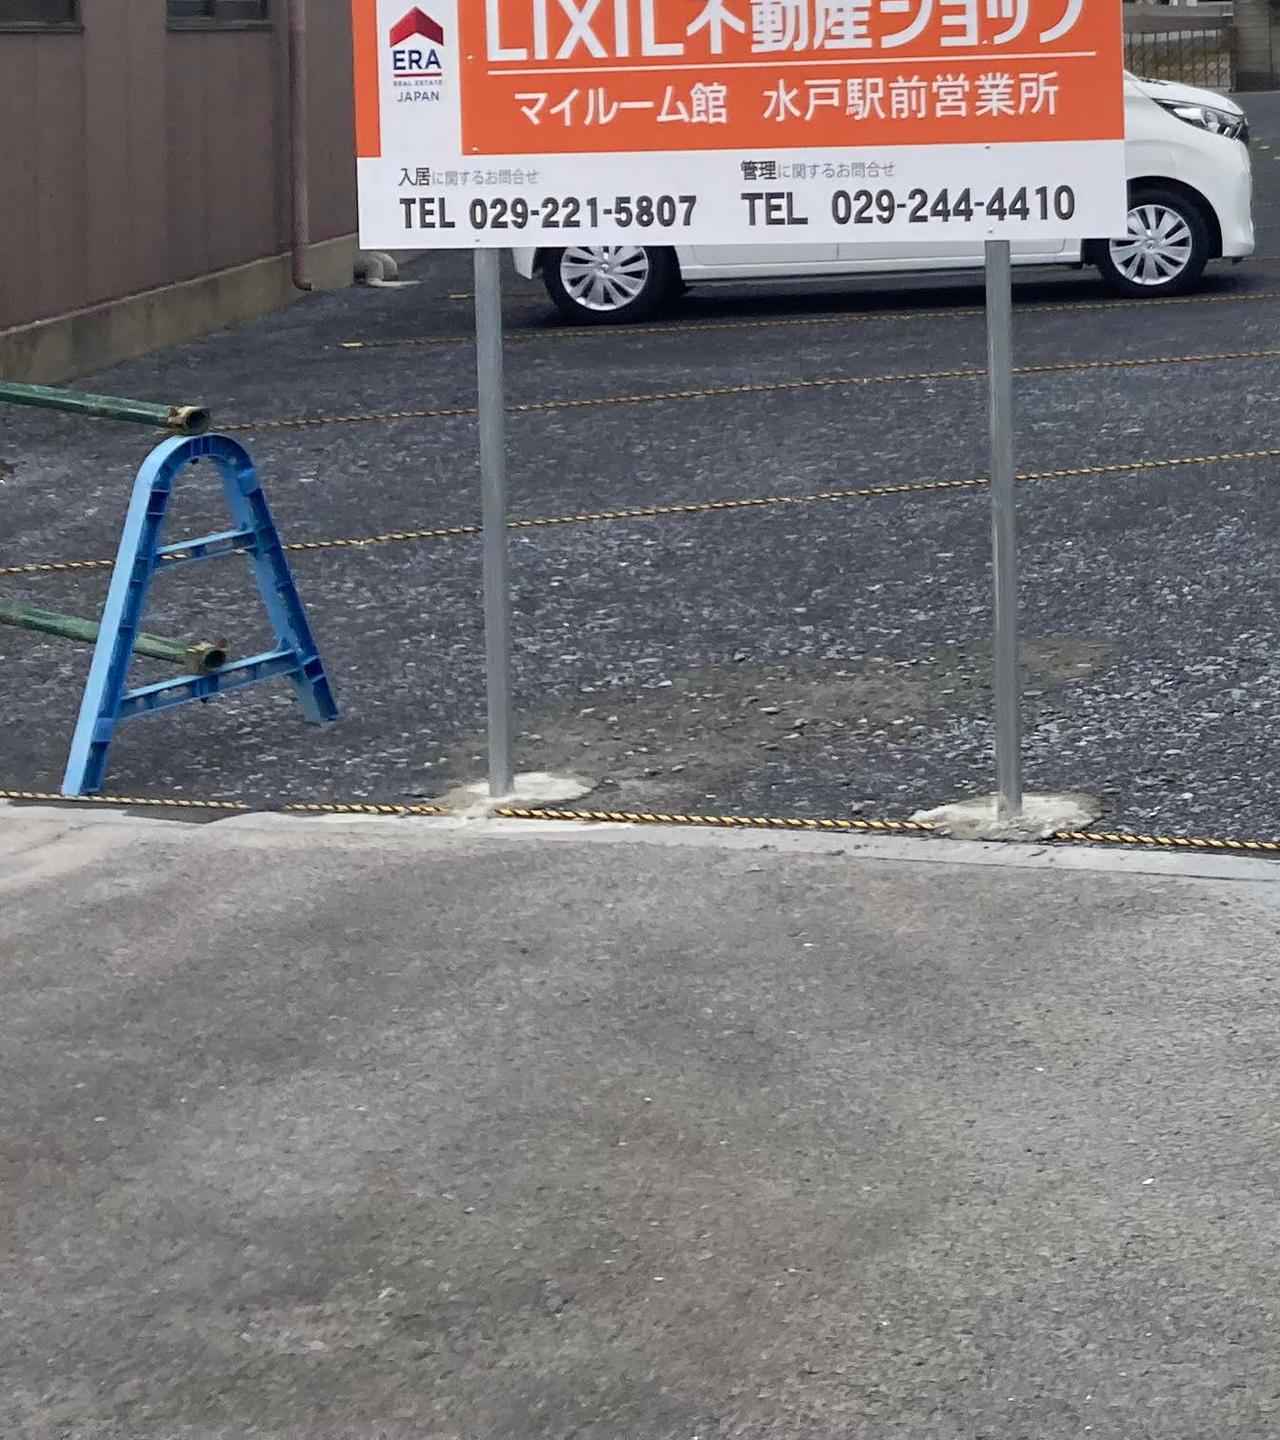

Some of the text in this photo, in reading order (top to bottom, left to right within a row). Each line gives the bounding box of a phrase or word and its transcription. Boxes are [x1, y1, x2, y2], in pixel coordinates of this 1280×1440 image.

[392, 49, 442, 70] ERA
[397, 91, 440, 102] JAPAN
[514, 71, 1059, 127] マイルーム館 水戸駅前営業所
[399, 167, 540, 187] 入居に関するお問合せ
[740, 160, 896, 181] 管理に関するお問合せ
[399, 194, 698, 229] TEL 029-221-5807
[740, 184, 1076, 226] TEL 029-244-4410
